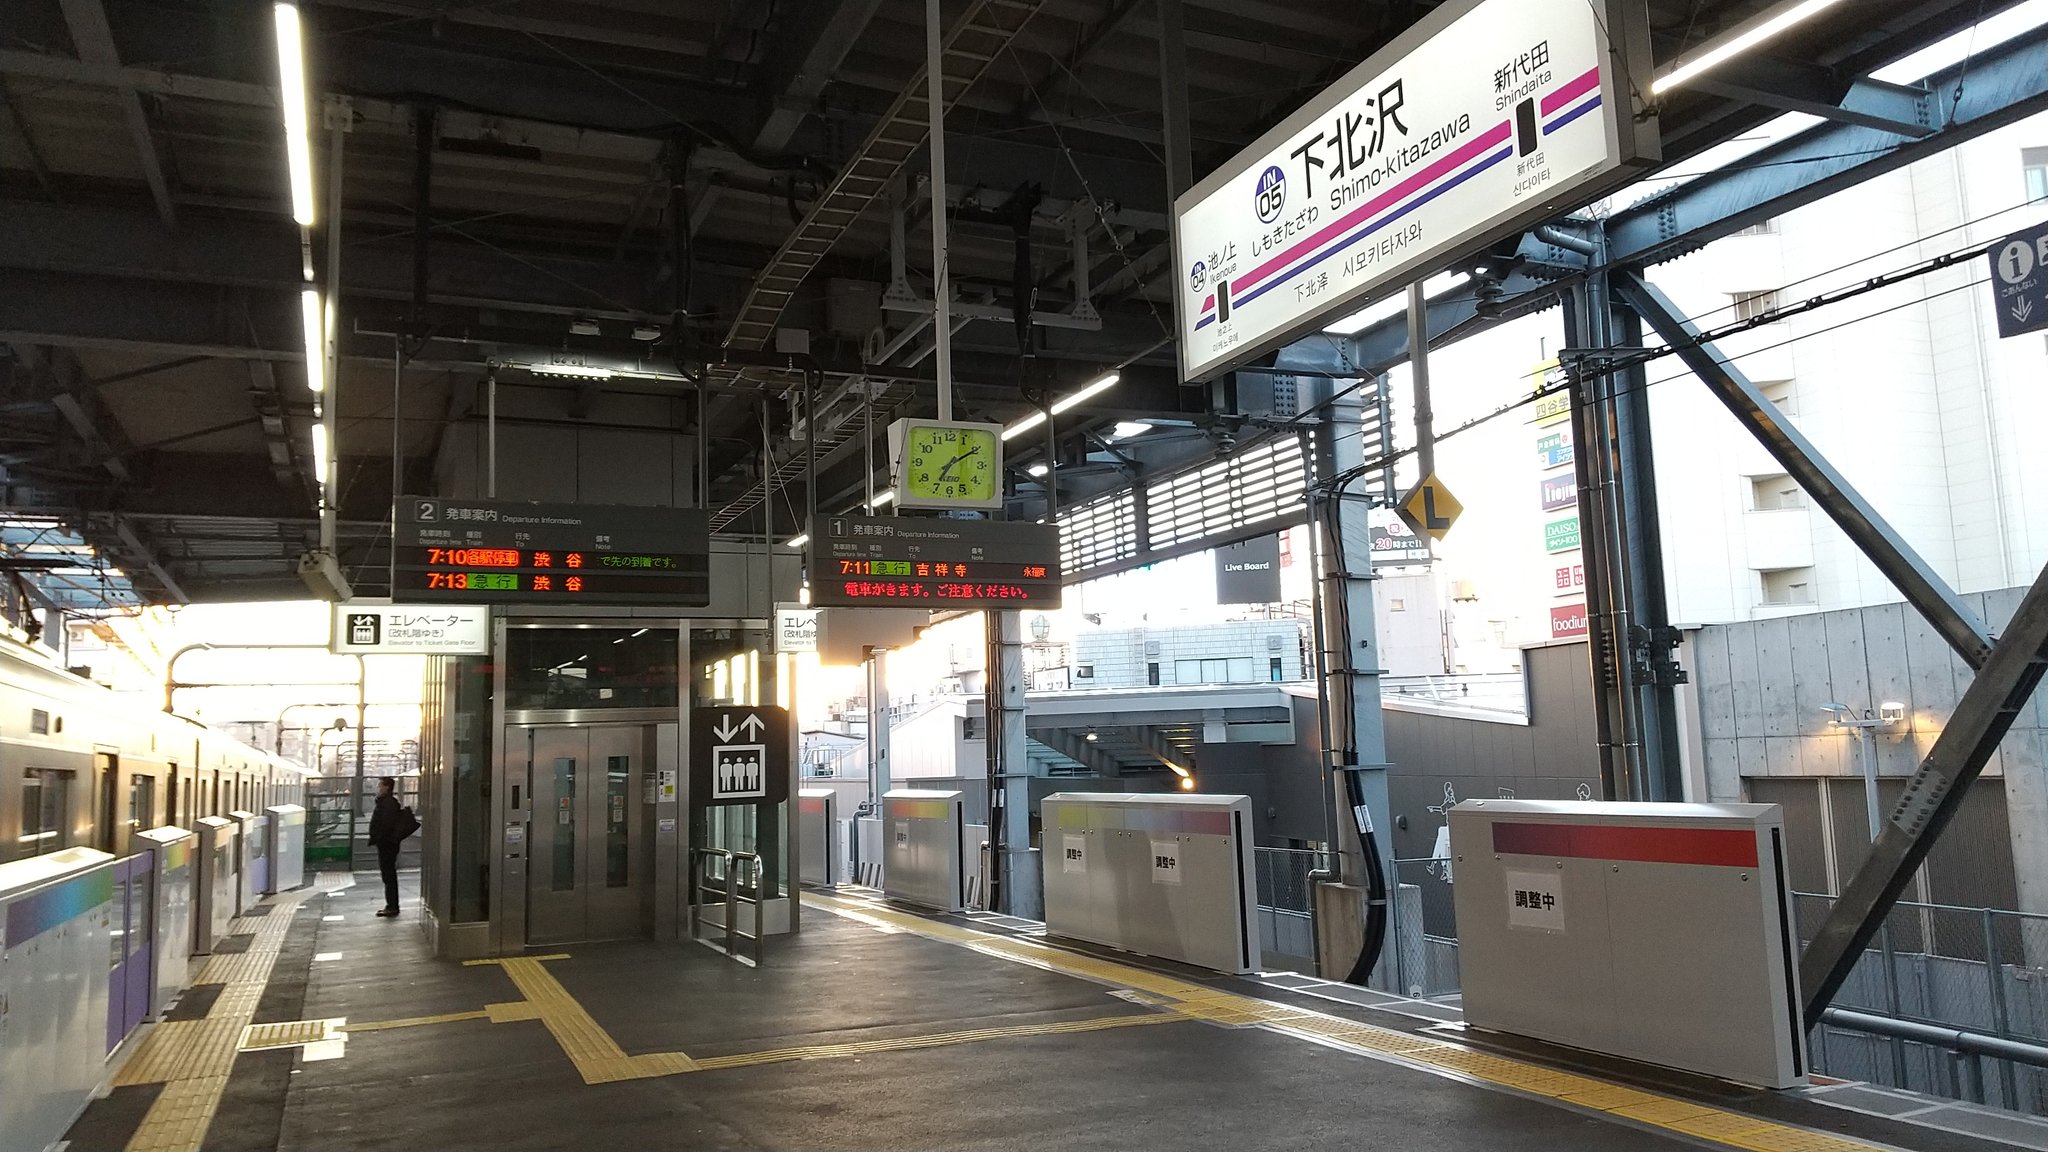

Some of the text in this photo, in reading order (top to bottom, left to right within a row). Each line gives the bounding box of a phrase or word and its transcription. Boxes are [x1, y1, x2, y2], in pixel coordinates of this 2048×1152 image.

[1494, 40, 1549, 93] 新代田
[1496, 70, 1552, 111] Shindaita
[1291, 78, 1408, 199] 下北沢
[1252, 113, 1470, 257] しもきたざわ Shimo-kitazawa
[1263, 169, 1276, 190] IN
[1259, 185, 1282, 217] 05
[1342, 220, 1422, 277] 시모키타자와
[1208, 241, 1237, 272] 池ノ上
[1194, 263, 1202, 274] IN
[1210, 263, 1237, 284] Ikenoue
[1192, 272, 1205, 289] 04
[944, 433, 957, 442] 12
[921, 444, 933, 454] 10
[915, 457, 923, 467] 9
[976, 461, 984, 470] 3
[920, 473, 929, 482] 8
[970, 475, 978, 484] 4
[933, 482, 941, 492] 7
[945, 485, 954, 495] 6
[958, 483, 966, 493] 5
[420, 503, 434, 520] 2
[445, 507, 498, 522] 発車案内
[1423, 486, 1450, 530] L
[502, 514, 582, 526] Departure Information
[833, 520, 842, 535] 1
[853, 524, 894, 537] 発車案内
[897, 530, 960, 540] Departure Information
[1547, 522, 1576, 537] DAISO
[427, 549, 467, 564] 7:10
[971, 554, 984, 562] Note
[840, 560, 870, 575] 7:11
[876, 562, 907, 575] 急行
[1224, 561, 1270, 572] Live Board
[427, 573, 467, 588] 7:13
[473, 575, 512, 589] 急行
[389, 614, 474, 627] エレベーター
[1514, 889, 1556, 911] 調整中
